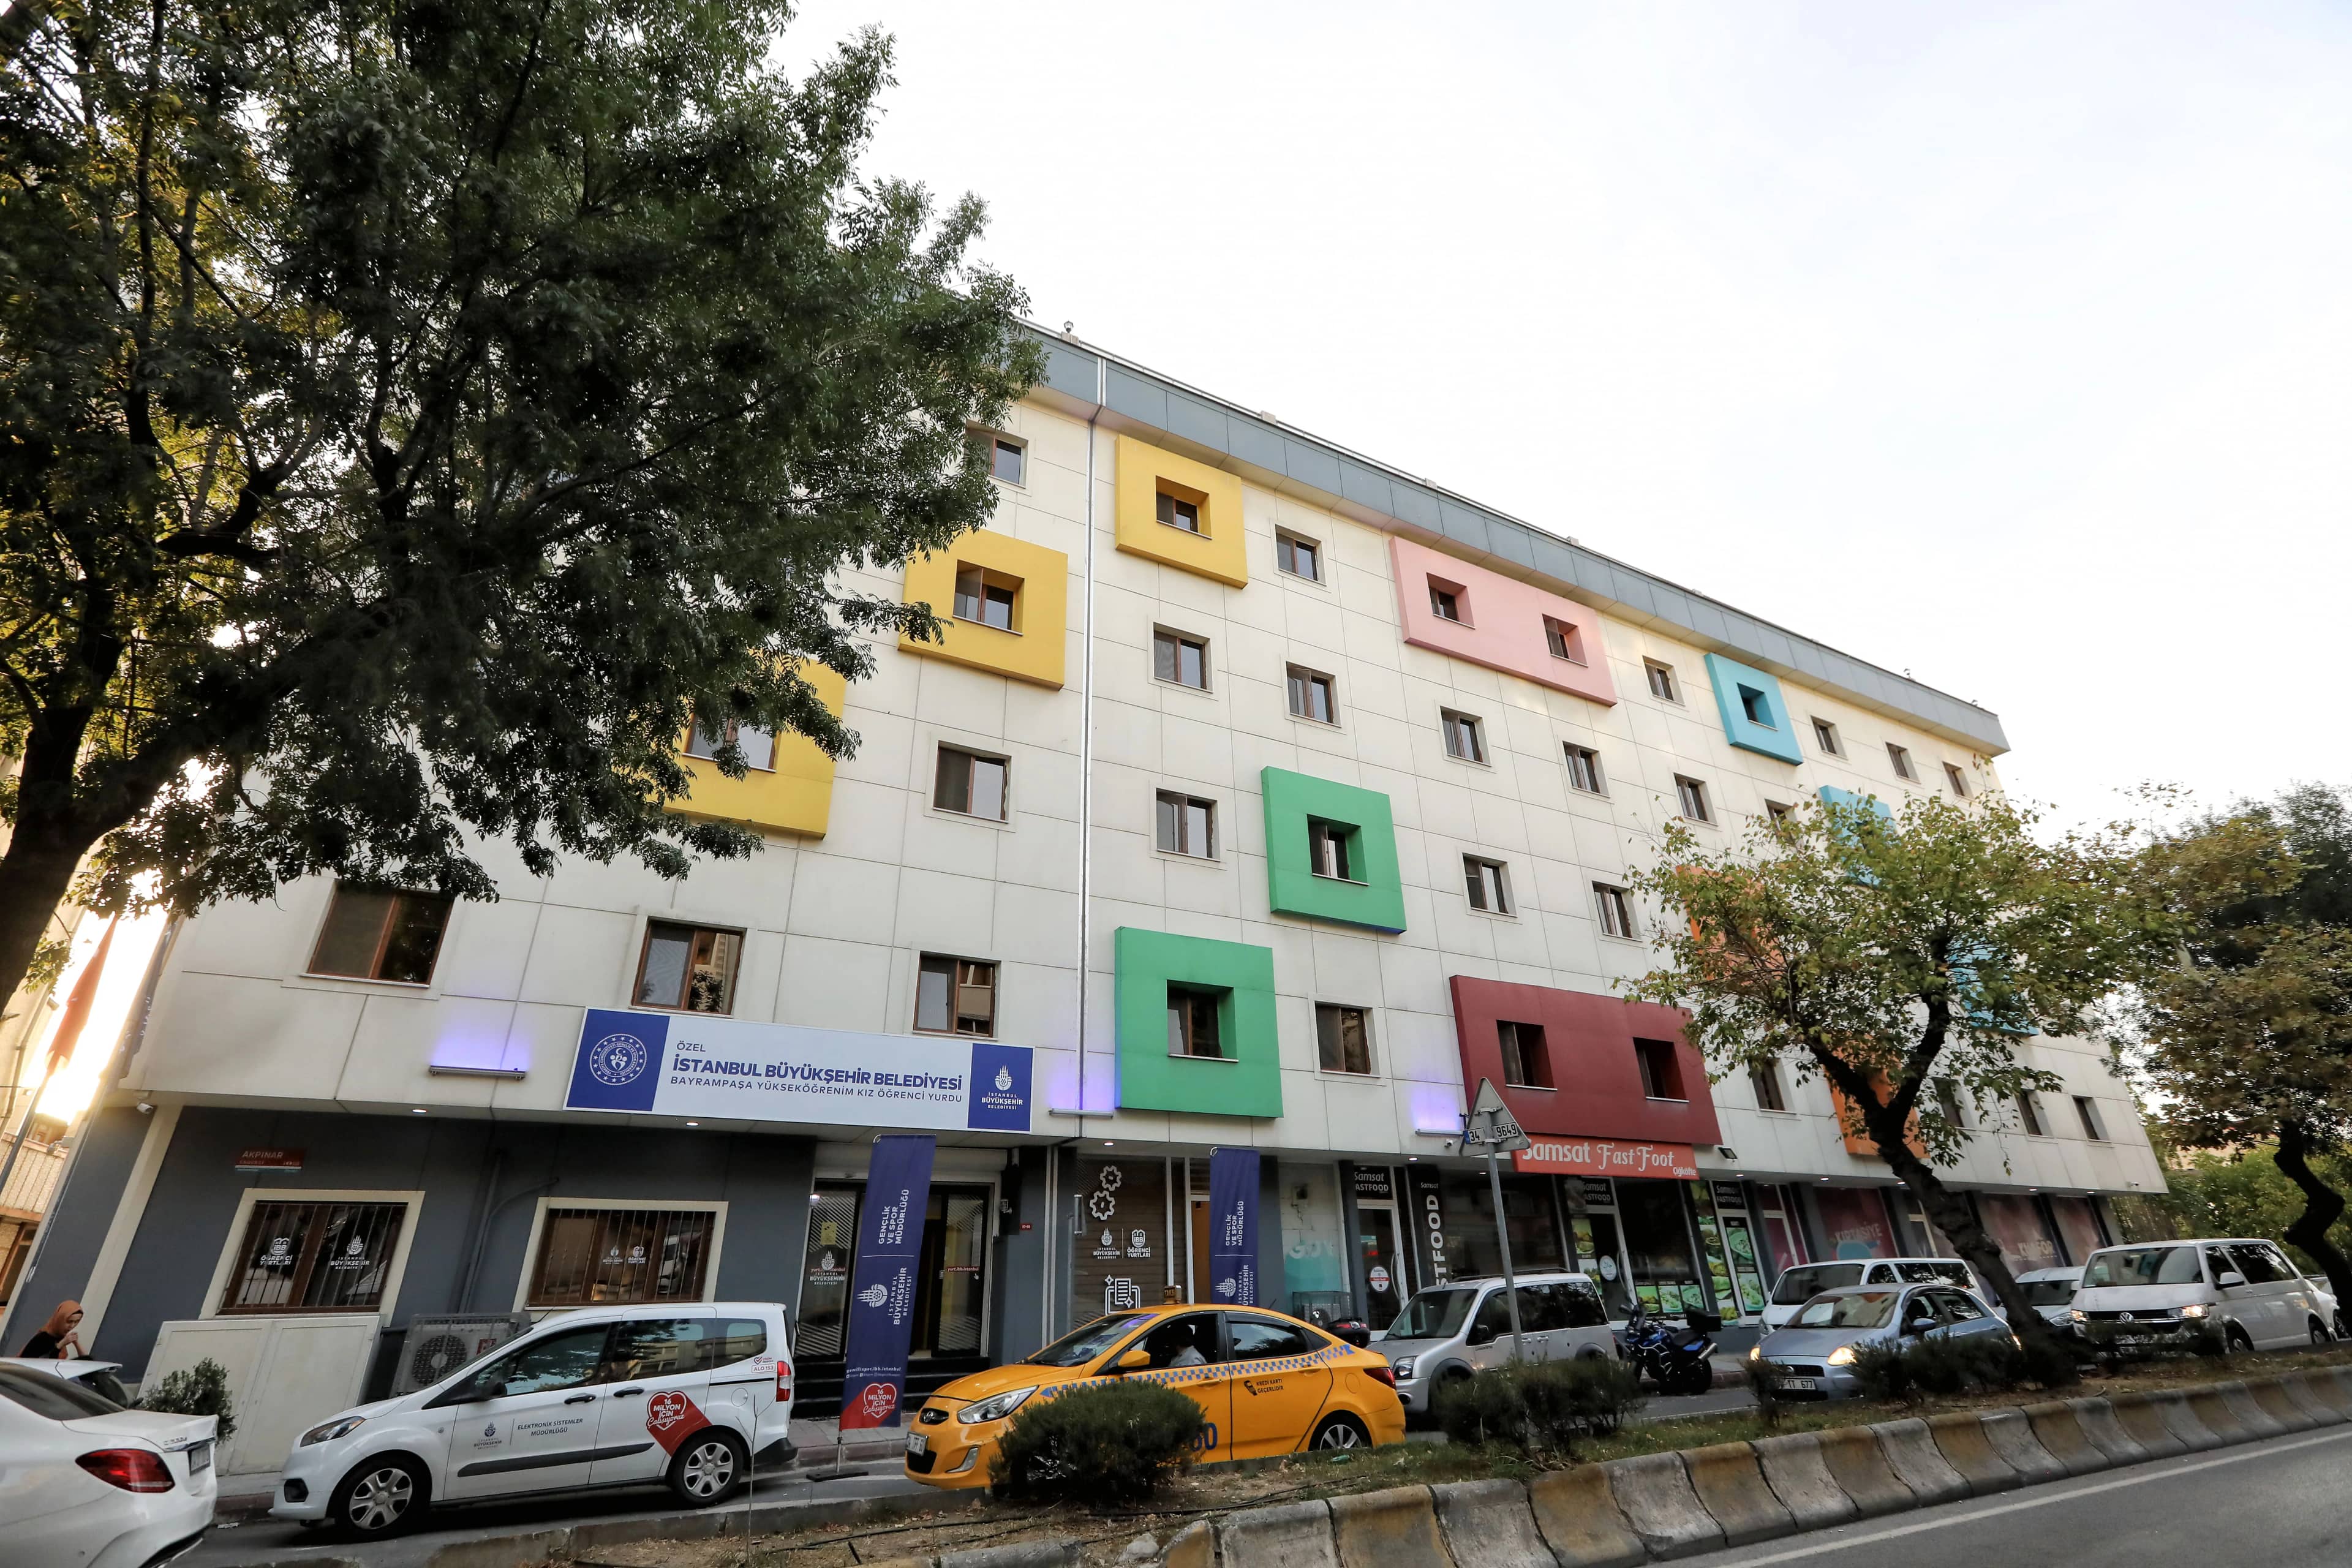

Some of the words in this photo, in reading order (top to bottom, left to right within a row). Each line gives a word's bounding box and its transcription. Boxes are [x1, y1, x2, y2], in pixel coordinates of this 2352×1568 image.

[677, 1041, 706, 1052] ÖZEL
[673, 1054, 761, 1077] İSTANBUL
[765, 1061, 871, 1084] BÜYÜKŞEHİR
[874, 1072, 962, 1090] BELEDİYESİ
[671, 1076, 752, 1090] BAYRAMPAŞA
[757, 1081, 853, 1095] YÜKSEKÖĞRENİM
[878, 1088, 925, 1100] ÖĞRENCİ
[928, 1093, 962, 1102] YURDU
[981, 1096, 1023, 1105] BÜYÜKŞEHİR
[1469, 1130, 1480, 1141] 34
[1496, 1124, 1517, 1137] 9649
[1522, 1137, 1591, 1163] Samsat
[1597, 1142, 1635, 1170] Fast
[1636, 1145, 1675, 1172] Foot
[1354, 1172, 1384, 1182] Samsat
[878, 1205, 891, 1244] GENÇLİK
[889, 1207, 898, 1231] SPOR
[895, 1189, 909, 1244] MÜDÜRLÜĞÜ
[886, 1232, 895, 1244] VE
[1231, 1235, 1237, 1246] VE
[1426, 1194, 1448, 1286] STFOOD
[888, 1276, 898, 1316] İSTANBUL
[893, 1267, 907, 1325] BÜYÜKŞEHİR
[903, 1276, 912, 1316] BELEDİYESİ
[1787, 1380, 1795, 1389] TT
[1801, 1380, 1813, 1389] 677
[530, 1427, 568, 1436] MÜDÜRLÜĞÜ
